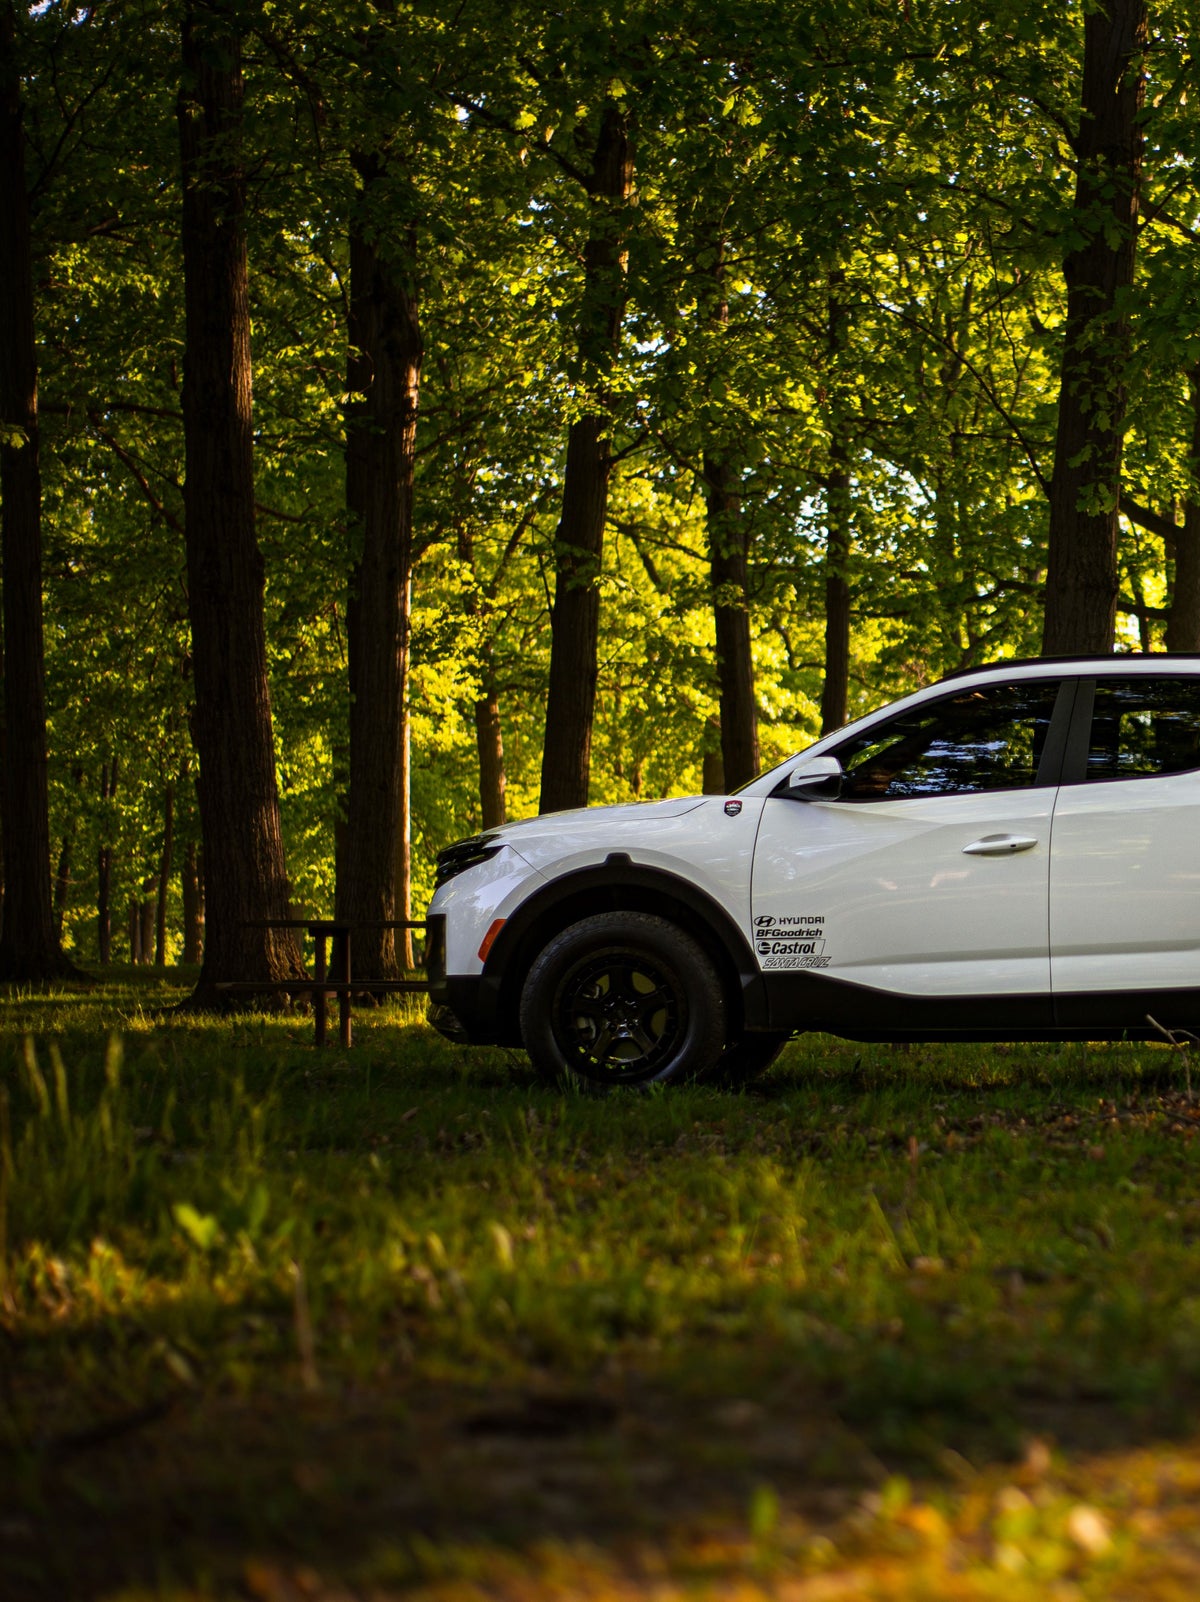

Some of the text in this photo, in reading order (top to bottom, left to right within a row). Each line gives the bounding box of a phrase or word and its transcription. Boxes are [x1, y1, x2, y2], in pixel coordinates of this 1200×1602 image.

[779, 916, 825, 925] HYUNDAI
[756, 928, 823, 937] BFGoodrich
[772, 942, 816, 954] Castrol
